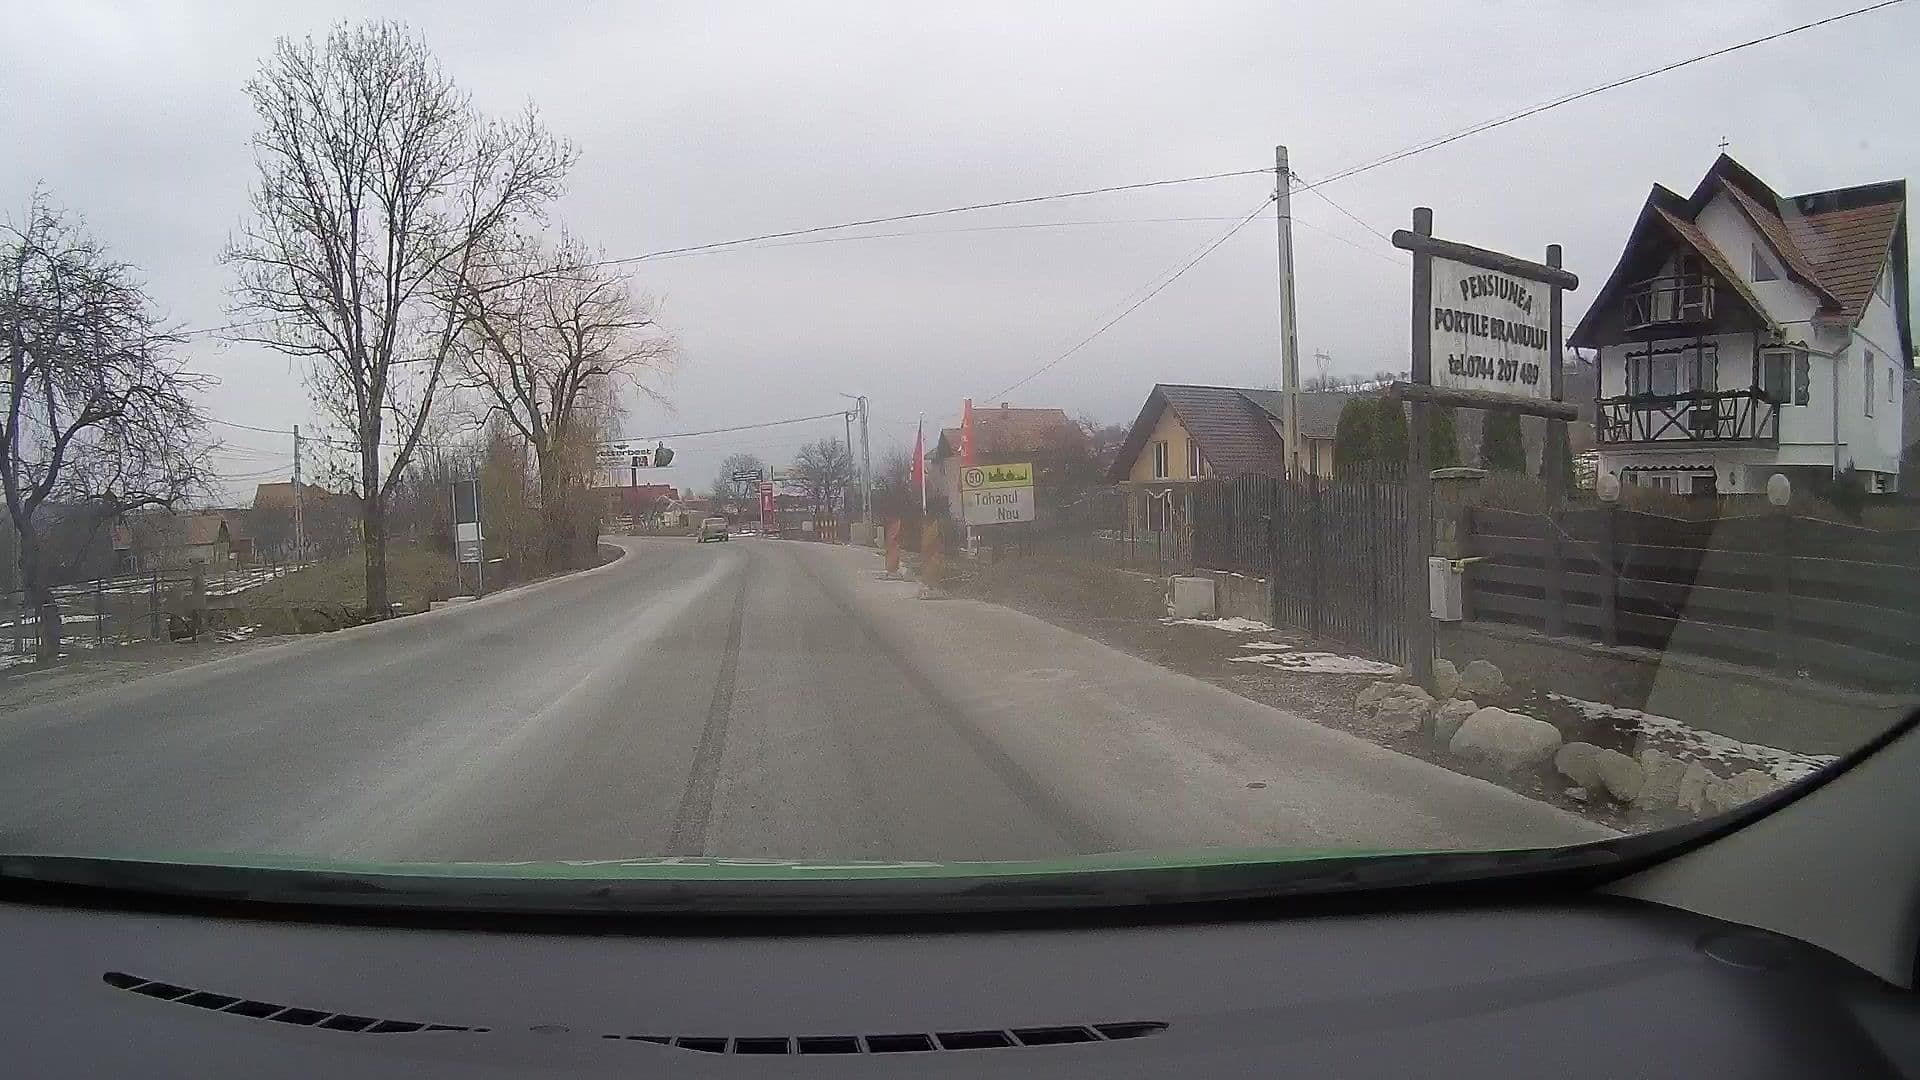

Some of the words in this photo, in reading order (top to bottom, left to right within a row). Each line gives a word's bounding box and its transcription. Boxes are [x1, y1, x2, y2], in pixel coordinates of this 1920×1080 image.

[1459, 274, 1533, 316] PENSIUNEA
[1434, 307, 1489, 340] PORTILE
[1490, 317, 1548, 351] BRANULUI
[1497, 357, 1518, 383] 207
[968, 472, 981, 484] 50
[974, 489, 1018, 506] Tohanul
[997, 507, 1019, 521] Nou
